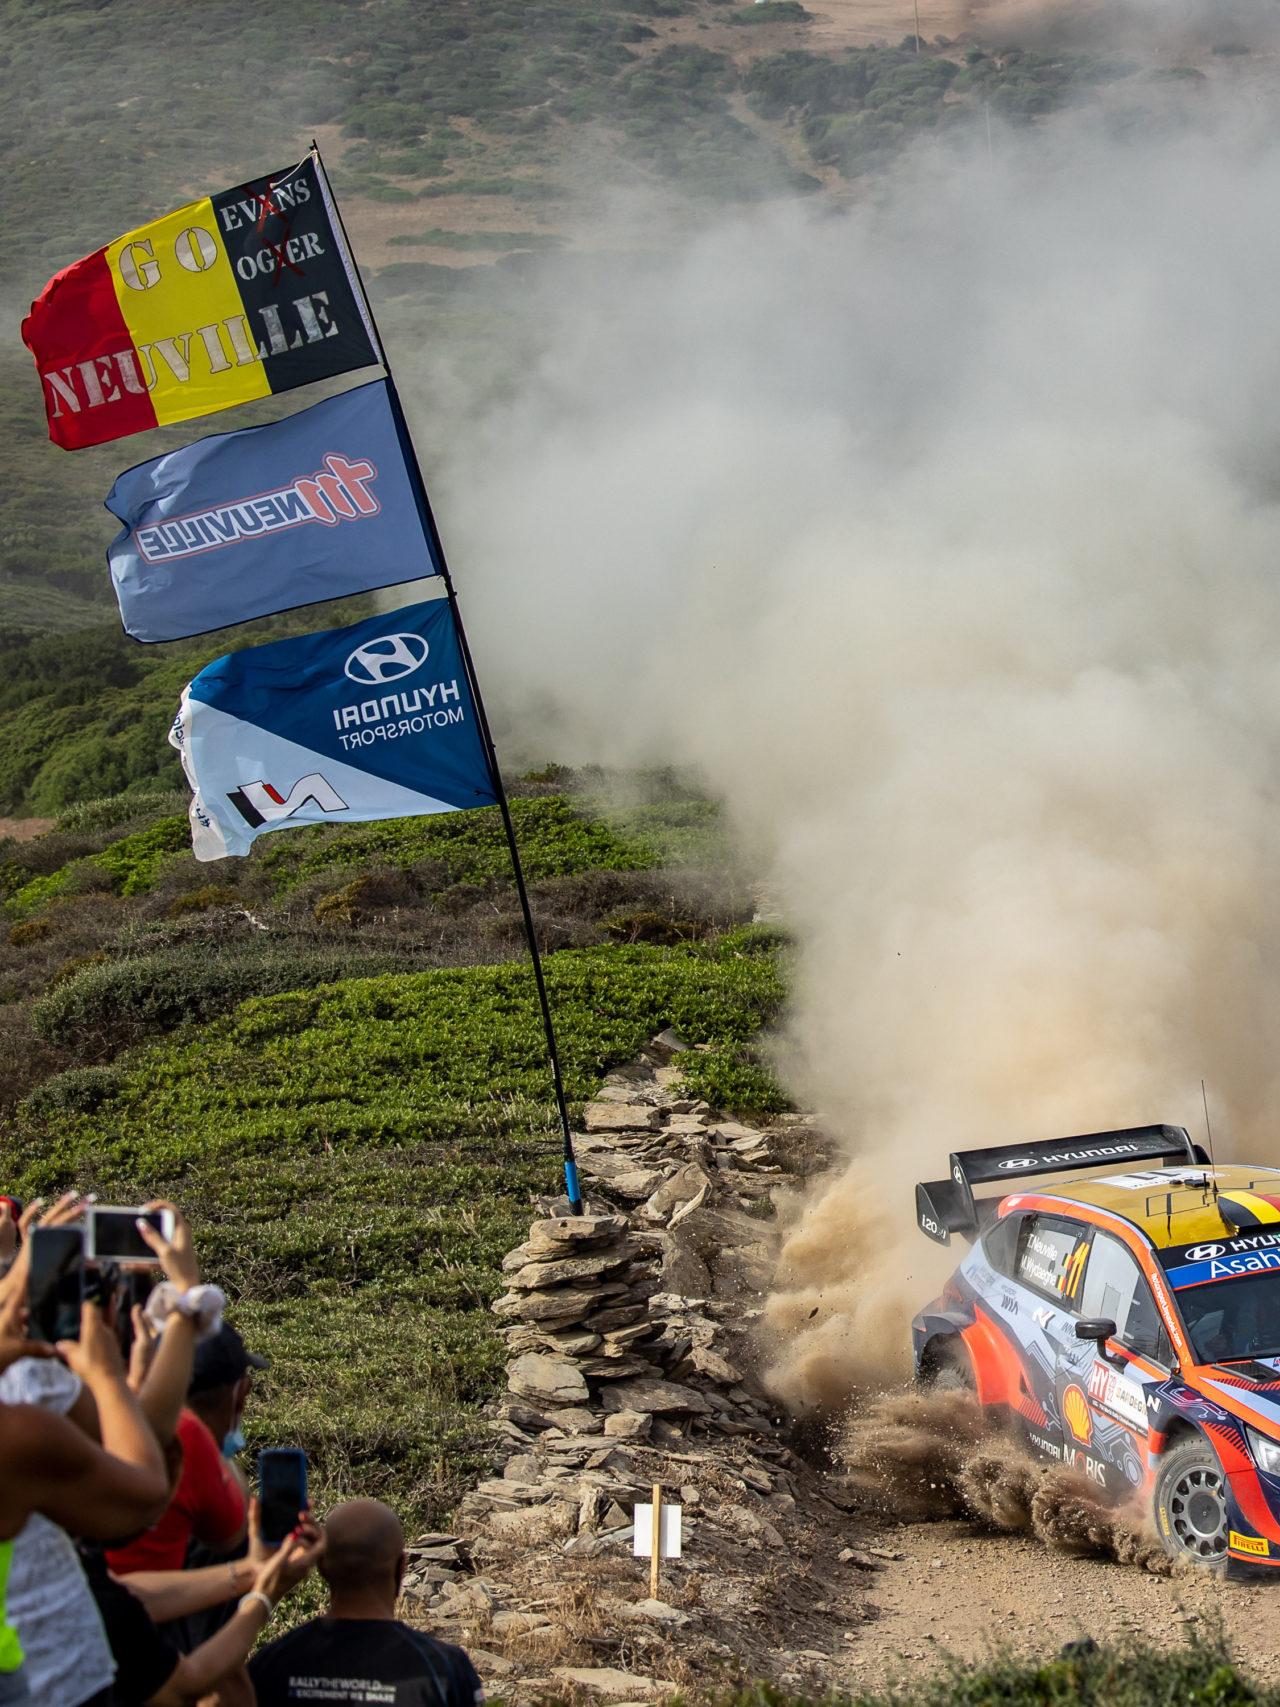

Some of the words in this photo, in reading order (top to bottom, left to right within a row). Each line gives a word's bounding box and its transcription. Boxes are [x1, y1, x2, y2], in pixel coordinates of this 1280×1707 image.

[220, 179, 311, 232] EVANS
[237, 232, 325, 280] OGIER
[44, 291, 339, 418] NEUVILLE
[1043, 1144, 1139, 1163] HYUNDAI
[1233, 1534, 1265, 1552] PIRELLI
